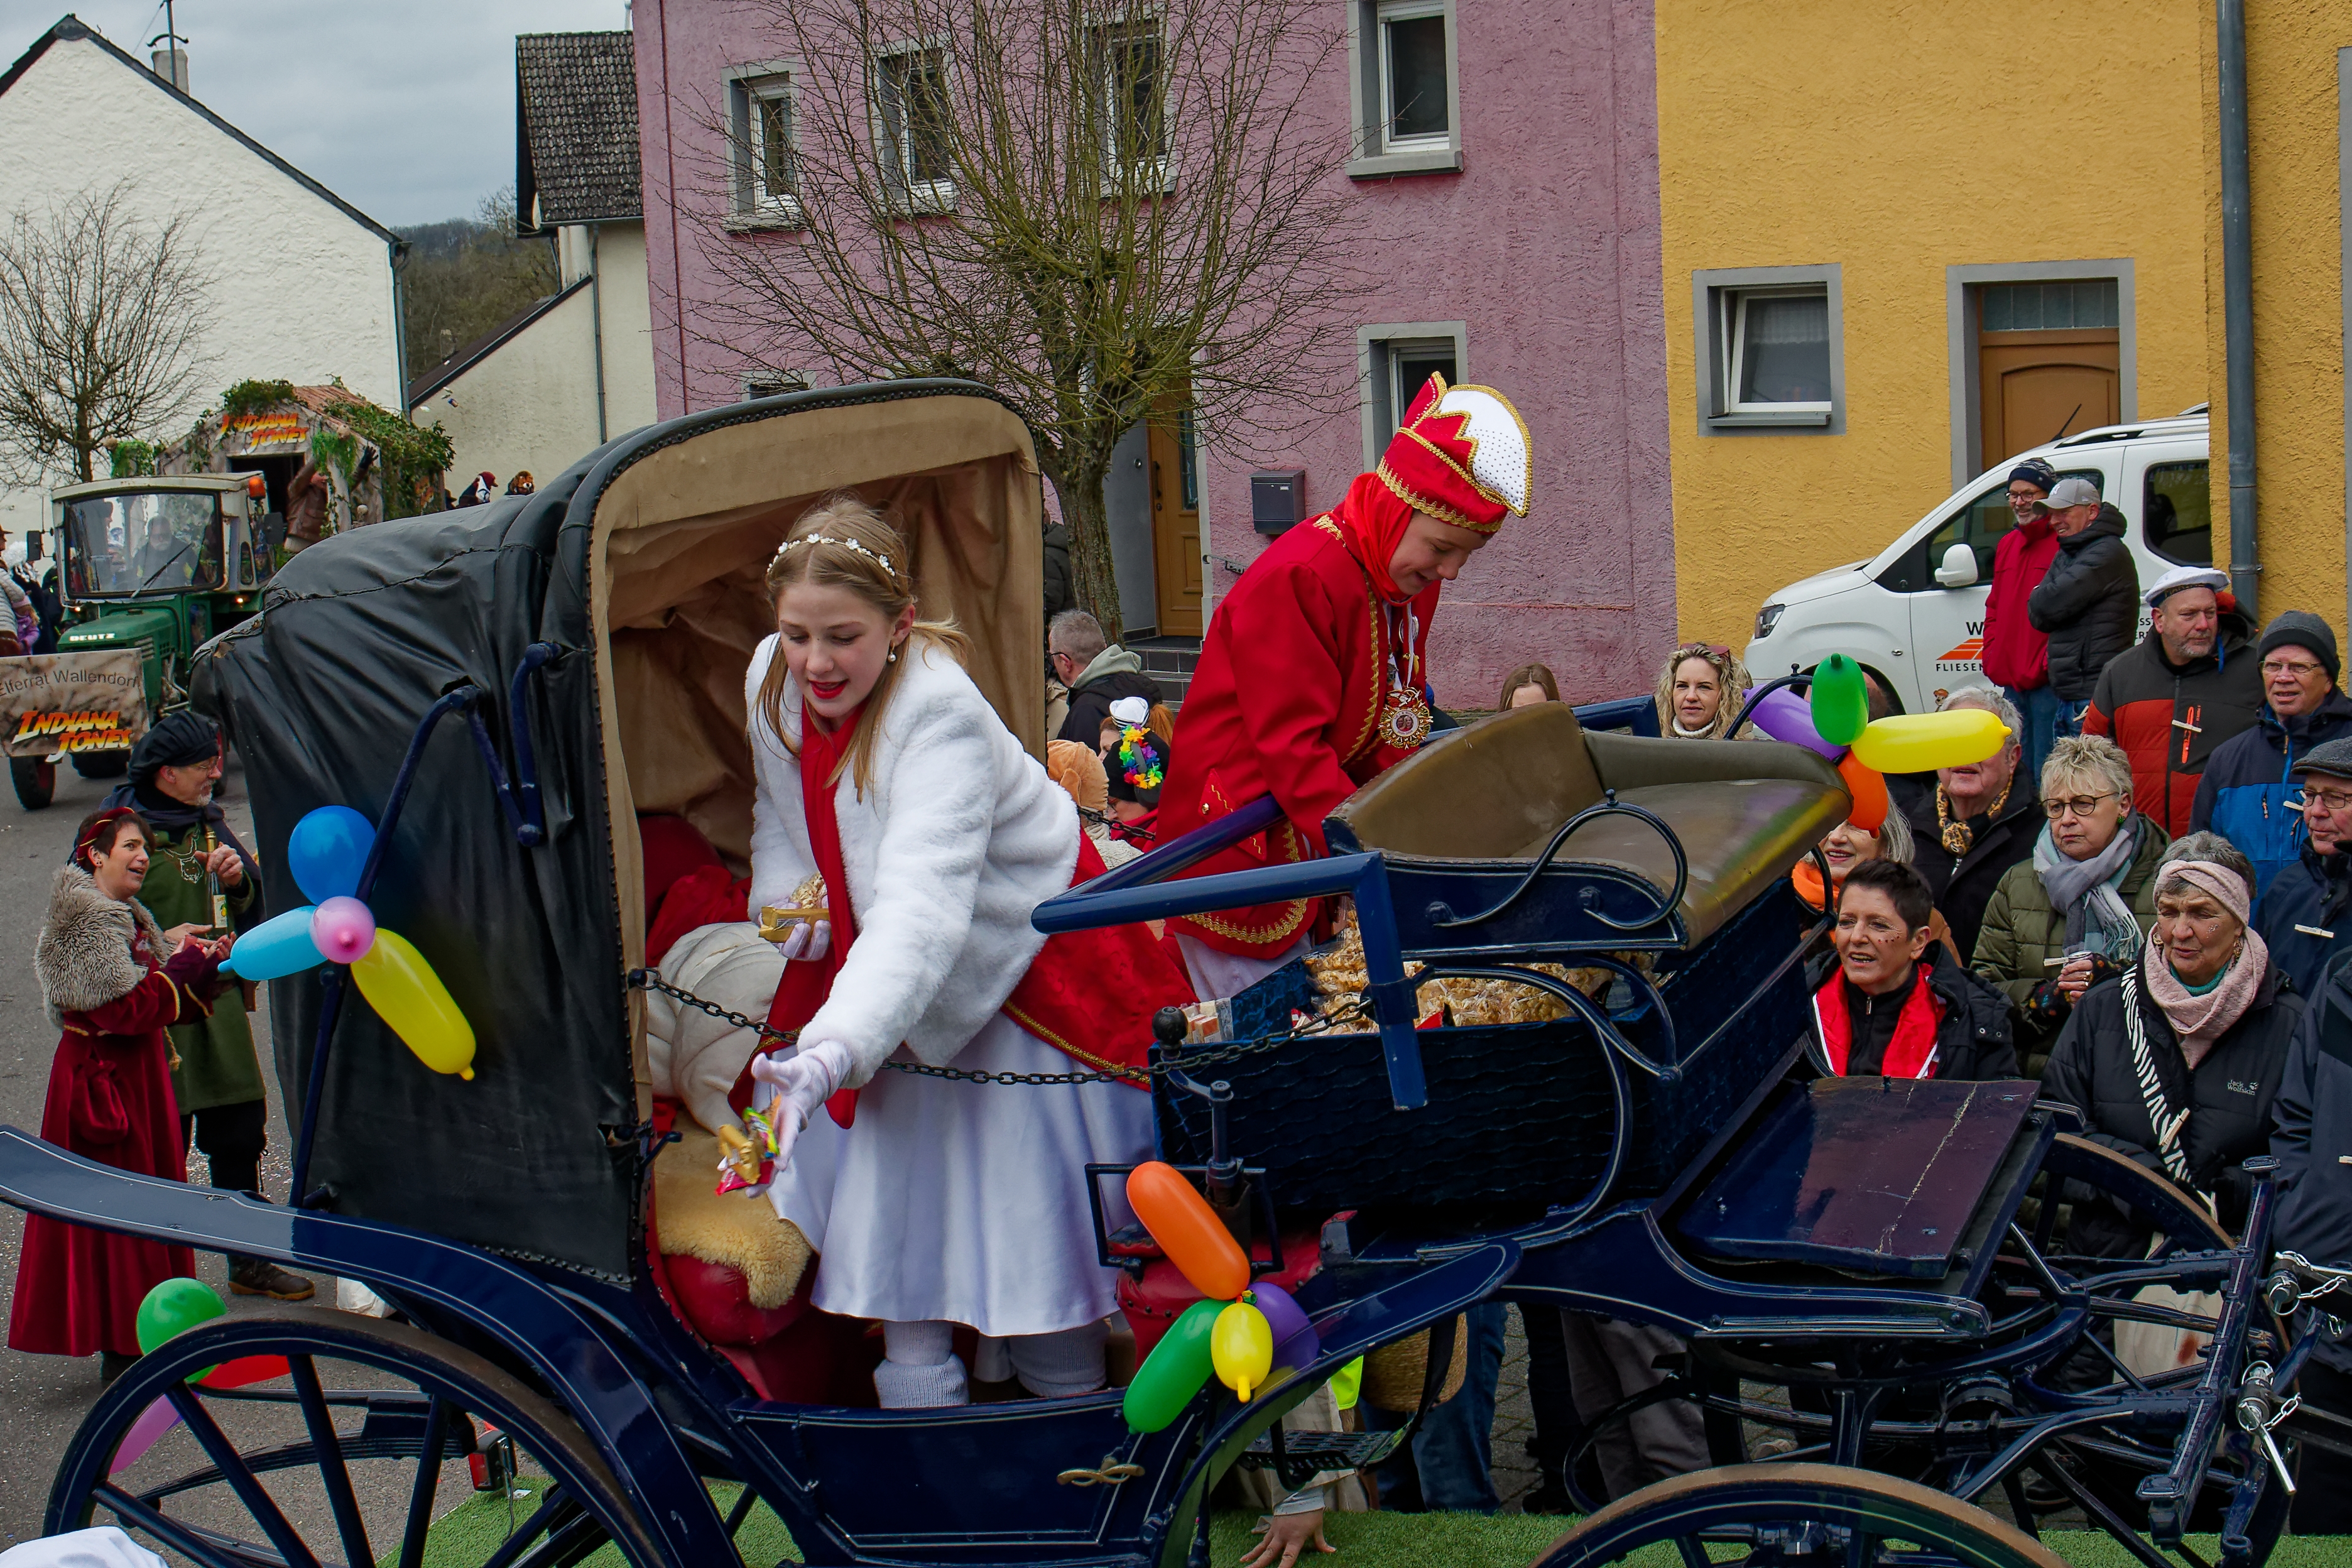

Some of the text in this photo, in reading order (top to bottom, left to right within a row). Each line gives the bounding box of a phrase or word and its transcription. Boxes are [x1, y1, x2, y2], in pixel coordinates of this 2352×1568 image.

[240, 427, 308, 455] JONES
[69, 633, 116, 641] DEUTZ
[53, 668, 139, 688] Wallendorf
[11, 710, 120, 745] INDIANA
[45, 729, 133, 763] JONES
